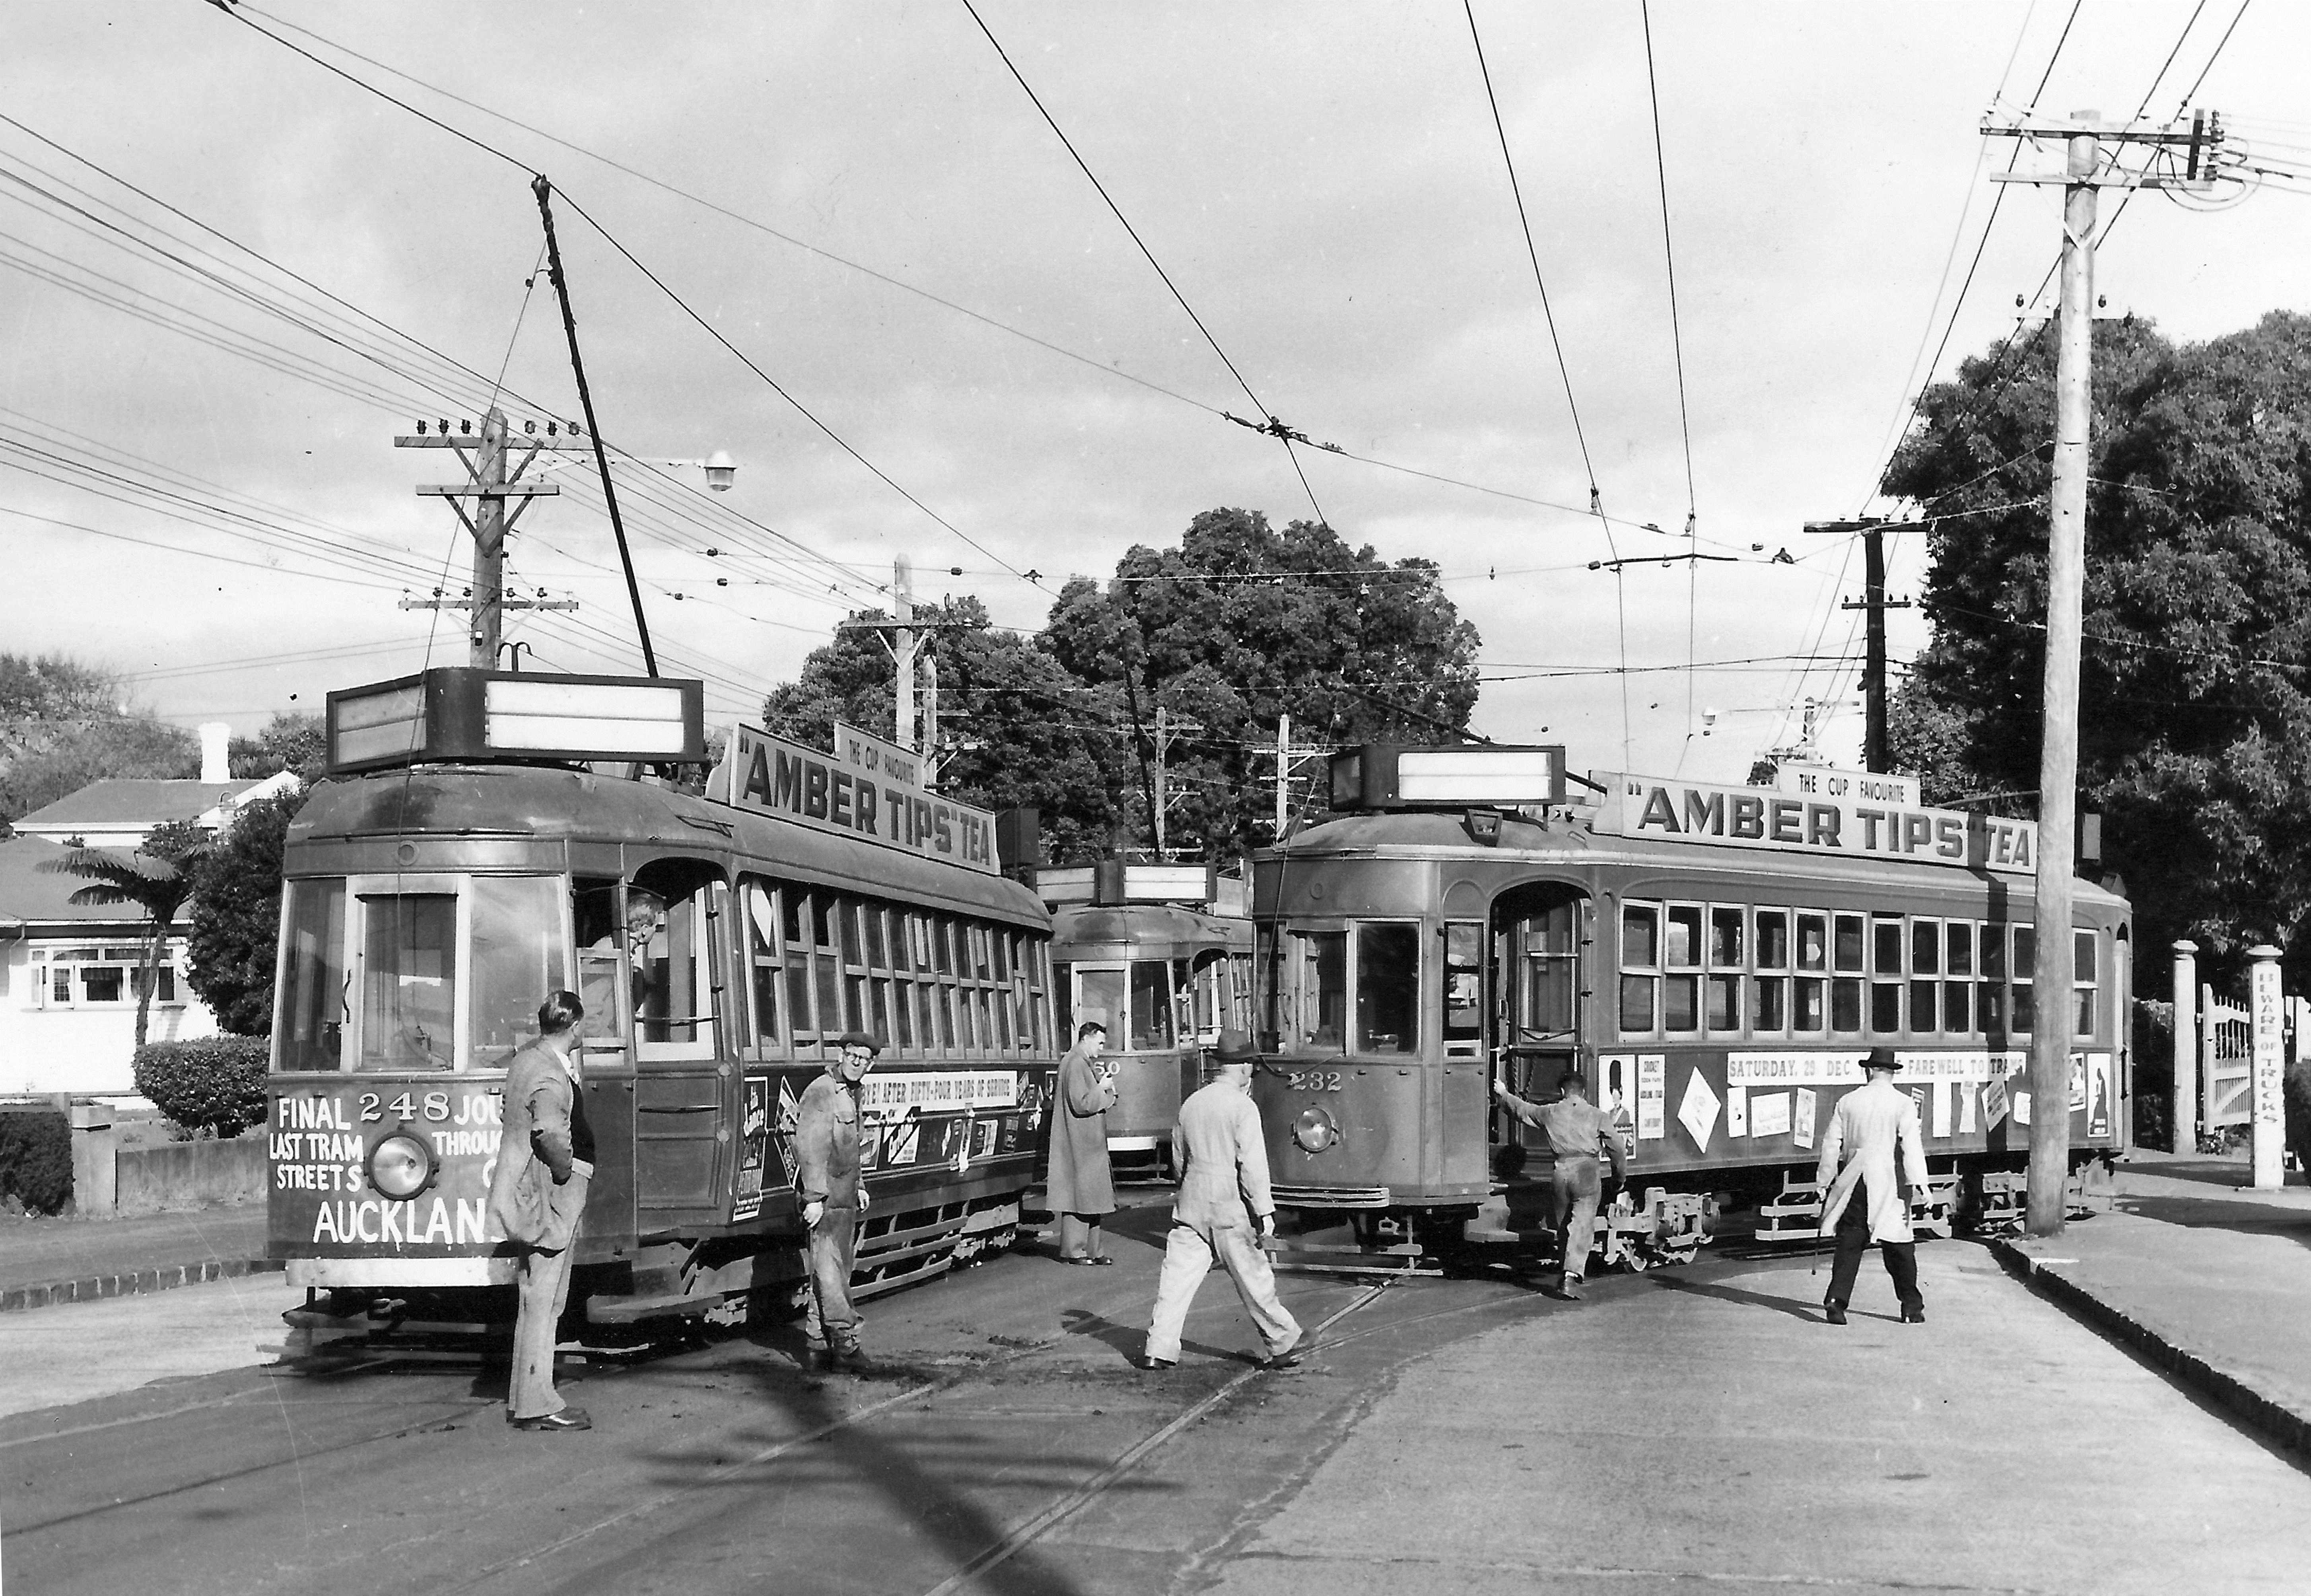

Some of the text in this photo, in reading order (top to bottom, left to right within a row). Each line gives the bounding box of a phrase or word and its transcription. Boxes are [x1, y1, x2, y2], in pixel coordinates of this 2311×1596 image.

[1799, 774, 1904, 803] THE CUP FAVOURITE
[960, 813, 990, 866] TEA
[1982, 823, 2029, 867] TEA
[2259, 974, 2278, 1123] BEWARE OF TRUCKS
[1908, 1059, 1964, 1075] FAREWELL
[1971, 1059, 1984, 1074] TO
[882, 1082, 906, 1103] AFTER
[910, 1080, 951, 1102] FIFTY-FOUR
[954, 1079, 974, 1099] YEARS
[977, 1079, 984, 1097] OF
[278, 1098, 351, 1130] FINAL
[359, 1092, 449, 1122] 248
[269, 1133, 303, 1161] LAST
[305, 1133, 364, 1162] TRAM
[277, 1164, 362, 1192] STREETS
[313, 1196, 507, 1245] AUCKLAN
